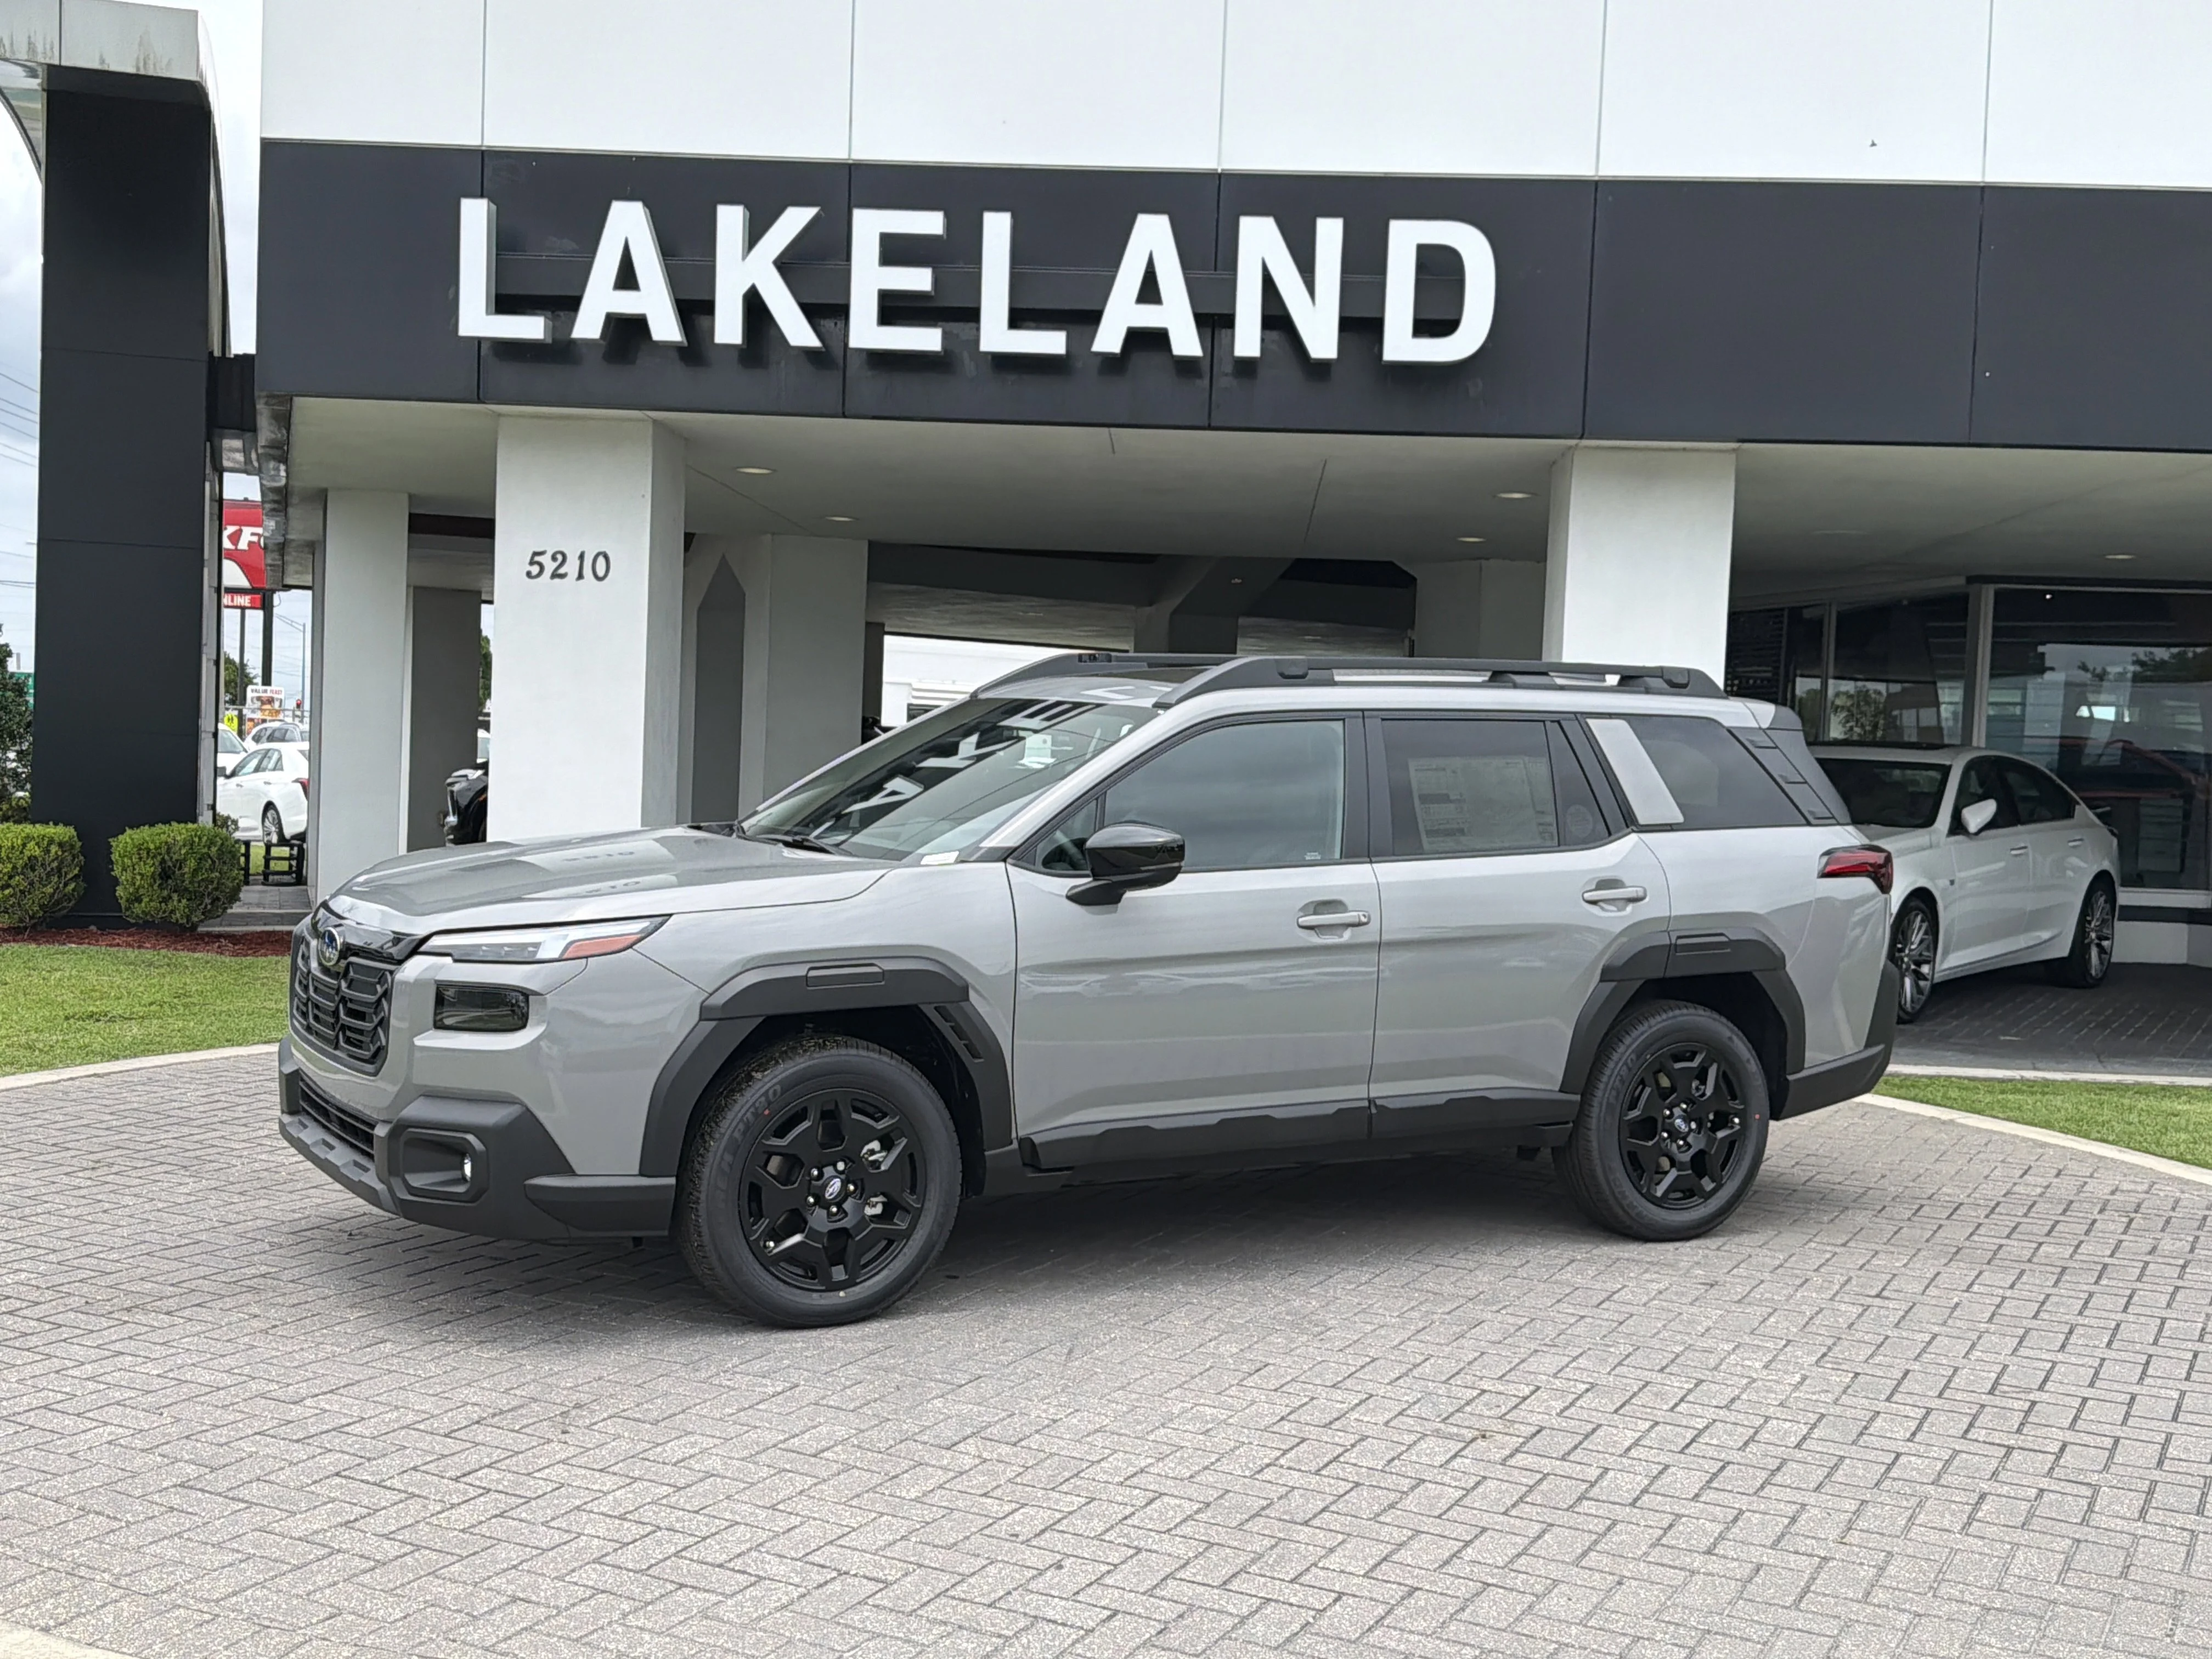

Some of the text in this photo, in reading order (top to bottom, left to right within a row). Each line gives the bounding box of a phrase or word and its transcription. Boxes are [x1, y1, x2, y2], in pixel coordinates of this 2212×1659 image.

[458, 198, 1496, 365] LAKELAND
[223, 525, 264, 550] KF
[526, 550, 611, 582] 5210
